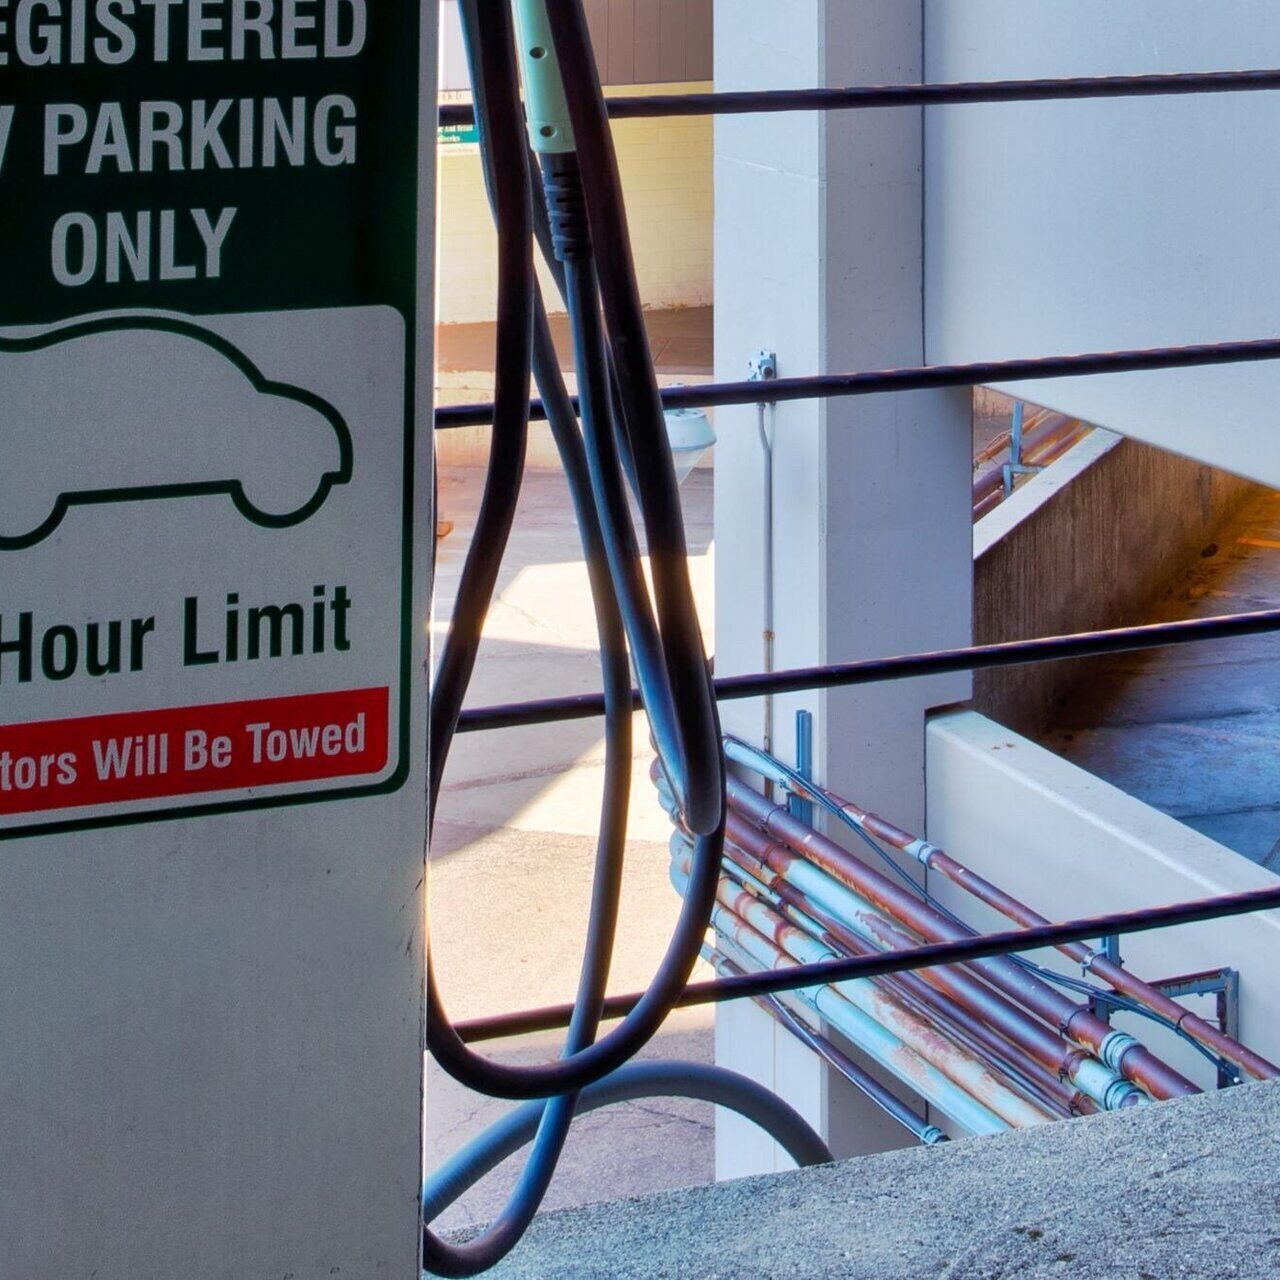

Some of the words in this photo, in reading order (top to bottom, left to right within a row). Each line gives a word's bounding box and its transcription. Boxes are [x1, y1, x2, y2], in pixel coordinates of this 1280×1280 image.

[43, 94, 357, 176] PARKING
[50, 206, 238, 287] ONLY
[183, 584, 352, 667] Limit
[92, 732, 169, 781] Will
[184, 729, 232, 771] Be
[245, 712, 366, 764] Towed
